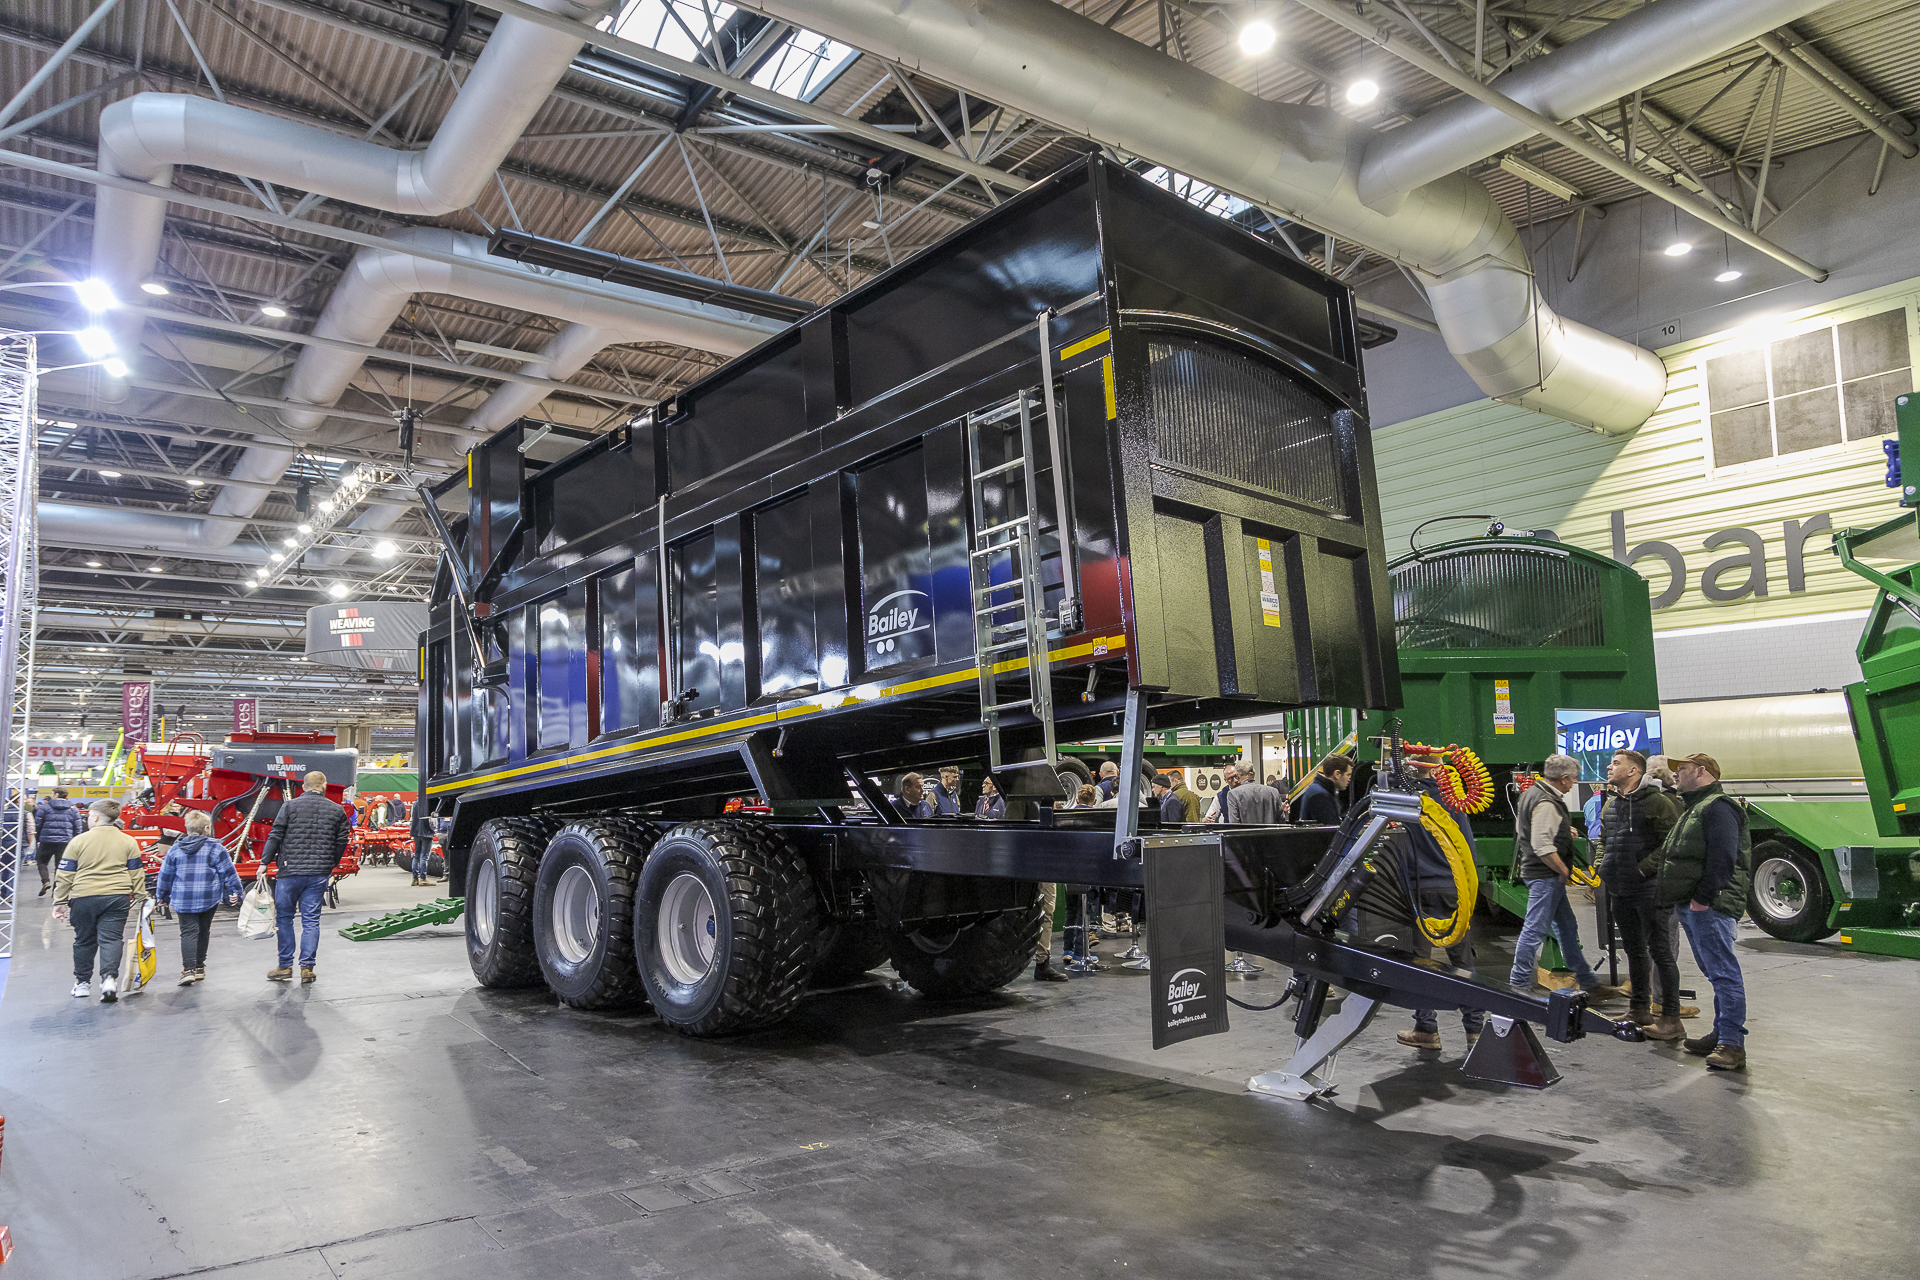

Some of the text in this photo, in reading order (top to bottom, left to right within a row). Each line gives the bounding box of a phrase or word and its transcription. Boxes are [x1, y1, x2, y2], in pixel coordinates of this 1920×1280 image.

[1661, 325, 1676, 336] 10
[1611, 509, 1831, 610] bar
[329, 617, 375, 630] WEAVING
[868, 607, 919, 637] Bailey
[124, 686, 143, 742] Acres
[1573, 724, 1641, 753] Bailey
[27, 746, 103, 757] STORTH
[266, 763, 306, 772] WEAVING
[1168, 980, 1200, 1001] Bailey
[1168, 1013, 1206, 1027] baileytrailers.co.uk
